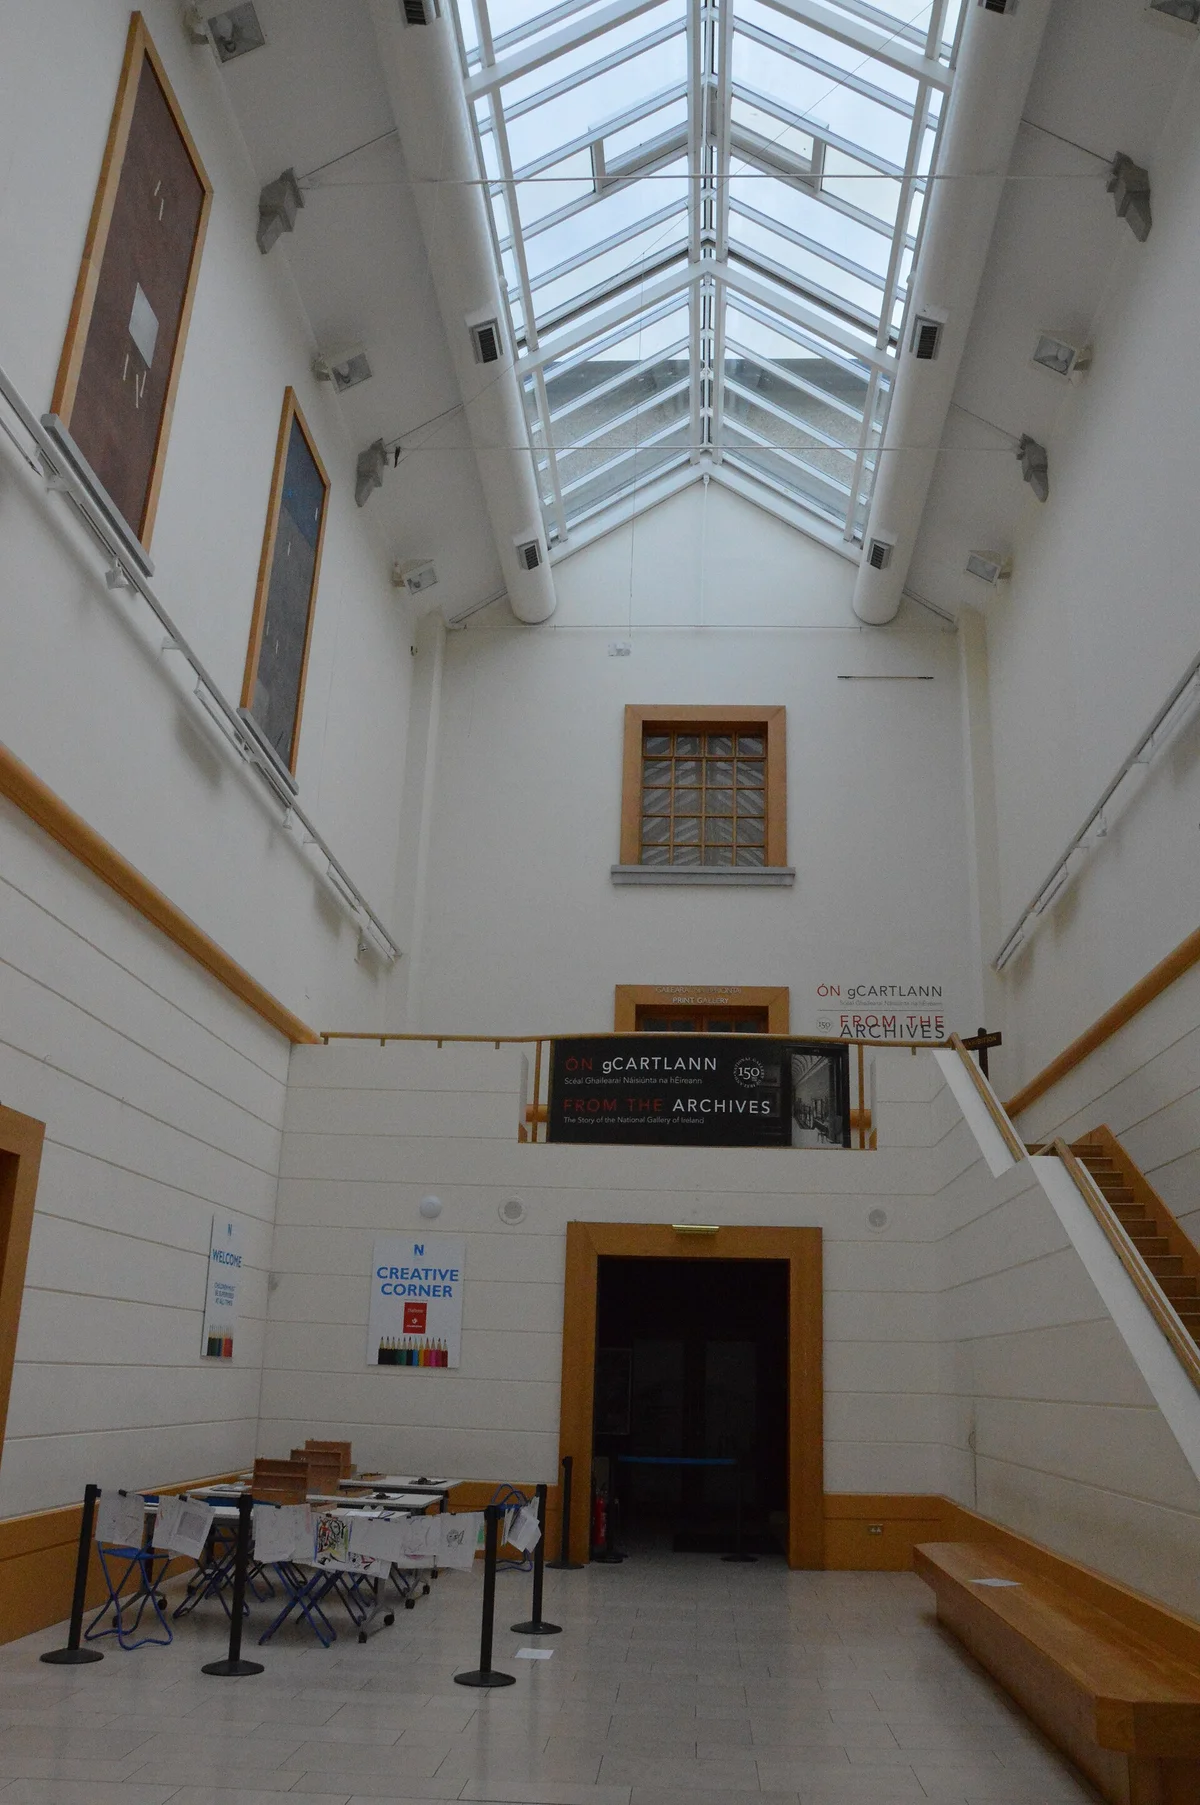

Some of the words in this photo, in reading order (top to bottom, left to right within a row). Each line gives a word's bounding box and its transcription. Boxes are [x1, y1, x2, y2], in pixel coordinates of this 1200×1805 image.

[817, 983, 841, 997] ÓN
[847, 985, 943, 999] gCARTLANN
[672, 996, 695, 1004] PRINT
[840, 1015, 896, 1028] FROM
[907, 1015, 944, 1028] THE
[840, 1024, 944, 1038] ARCHIVES
[565, 1056, 593, 1071] ÓN
[602, 1057, 717, 1074] gCARTLANN
[564, 1076, 583, 1085] Scéal
[623, 1076, 657, 1085] Náisiúnta
[669, 1076, 703, 1085] hÉireann
[738, 1067, 760, 1080] 150
[563, 1098, 617, 1112] FROM
[627, 1098, 663, 1112] THE
[672, 1099, 770, 1114] ARCHIVES
[564, 1116, 576, 1124] The
[577, 1116, 595, 1125] Story
[596, 1116, 604, 1124] of
[605, 1116, 616, 1124] the
[617, 1116, 645, 1124] National
[647, 1116, 671, 1125] Gallery
[672, 1116, 680, 1124] of
[681, 1117, 705, 1125] Ireland
[414, 1244, 424, 1256] N
[212, 1249, 242, 1268] WELCOME
[377, 1266, 459, 1281] CREATIVE
[381, 1283, 453, 1297] CORNER
